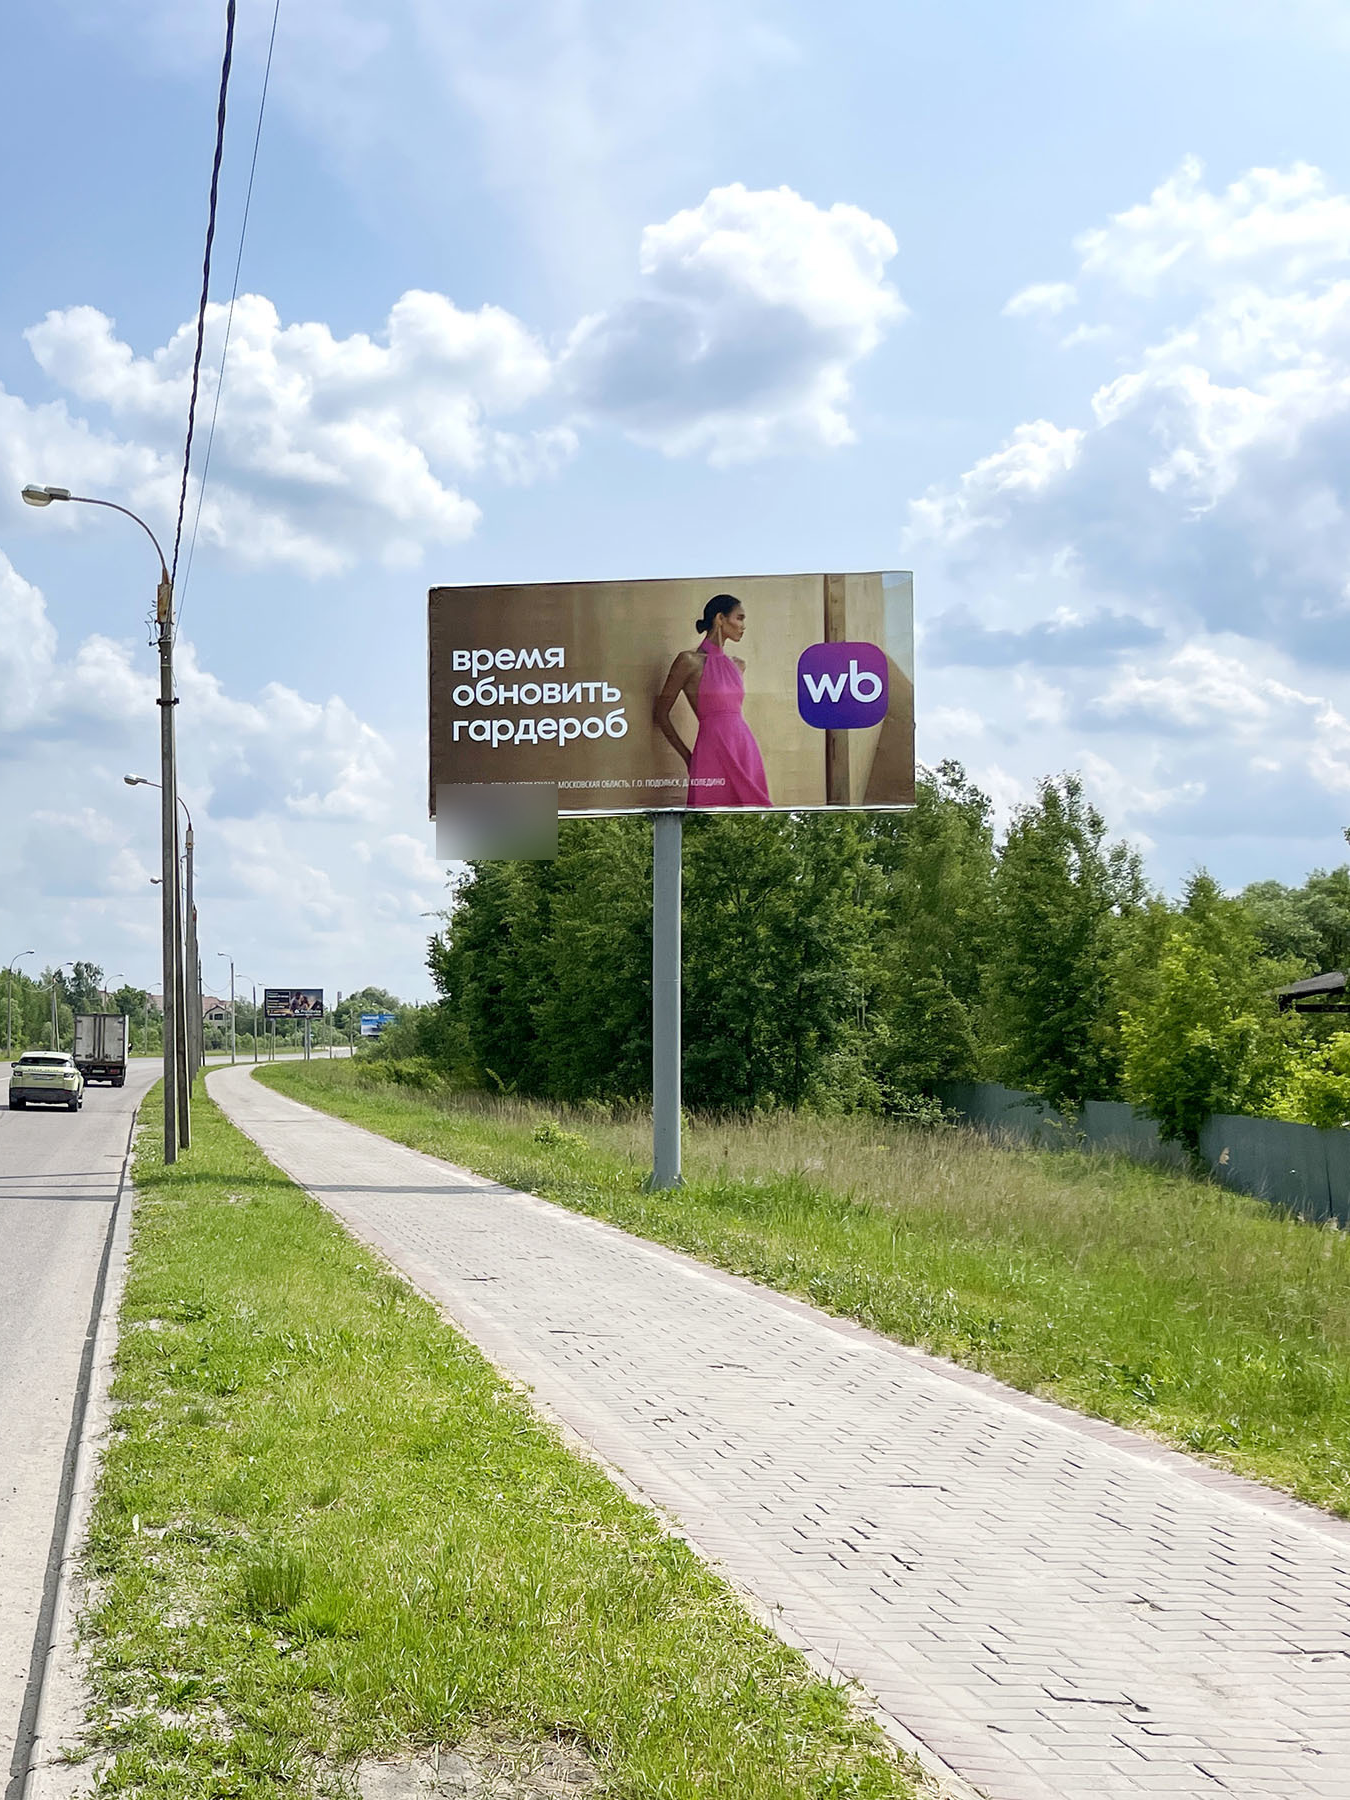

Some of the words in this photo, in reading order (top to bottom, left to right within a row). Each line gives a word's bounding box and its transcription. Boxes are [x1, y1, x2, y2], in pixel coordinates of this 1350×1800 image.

[452, 647, 565, 678] время
[452, 675, 622, 707] обновить
[802, 660, 883, 703] wb
[452, 707, 628, 748] гардероб
[558, 780, 600, 789] МОСКОВСКАЯ
